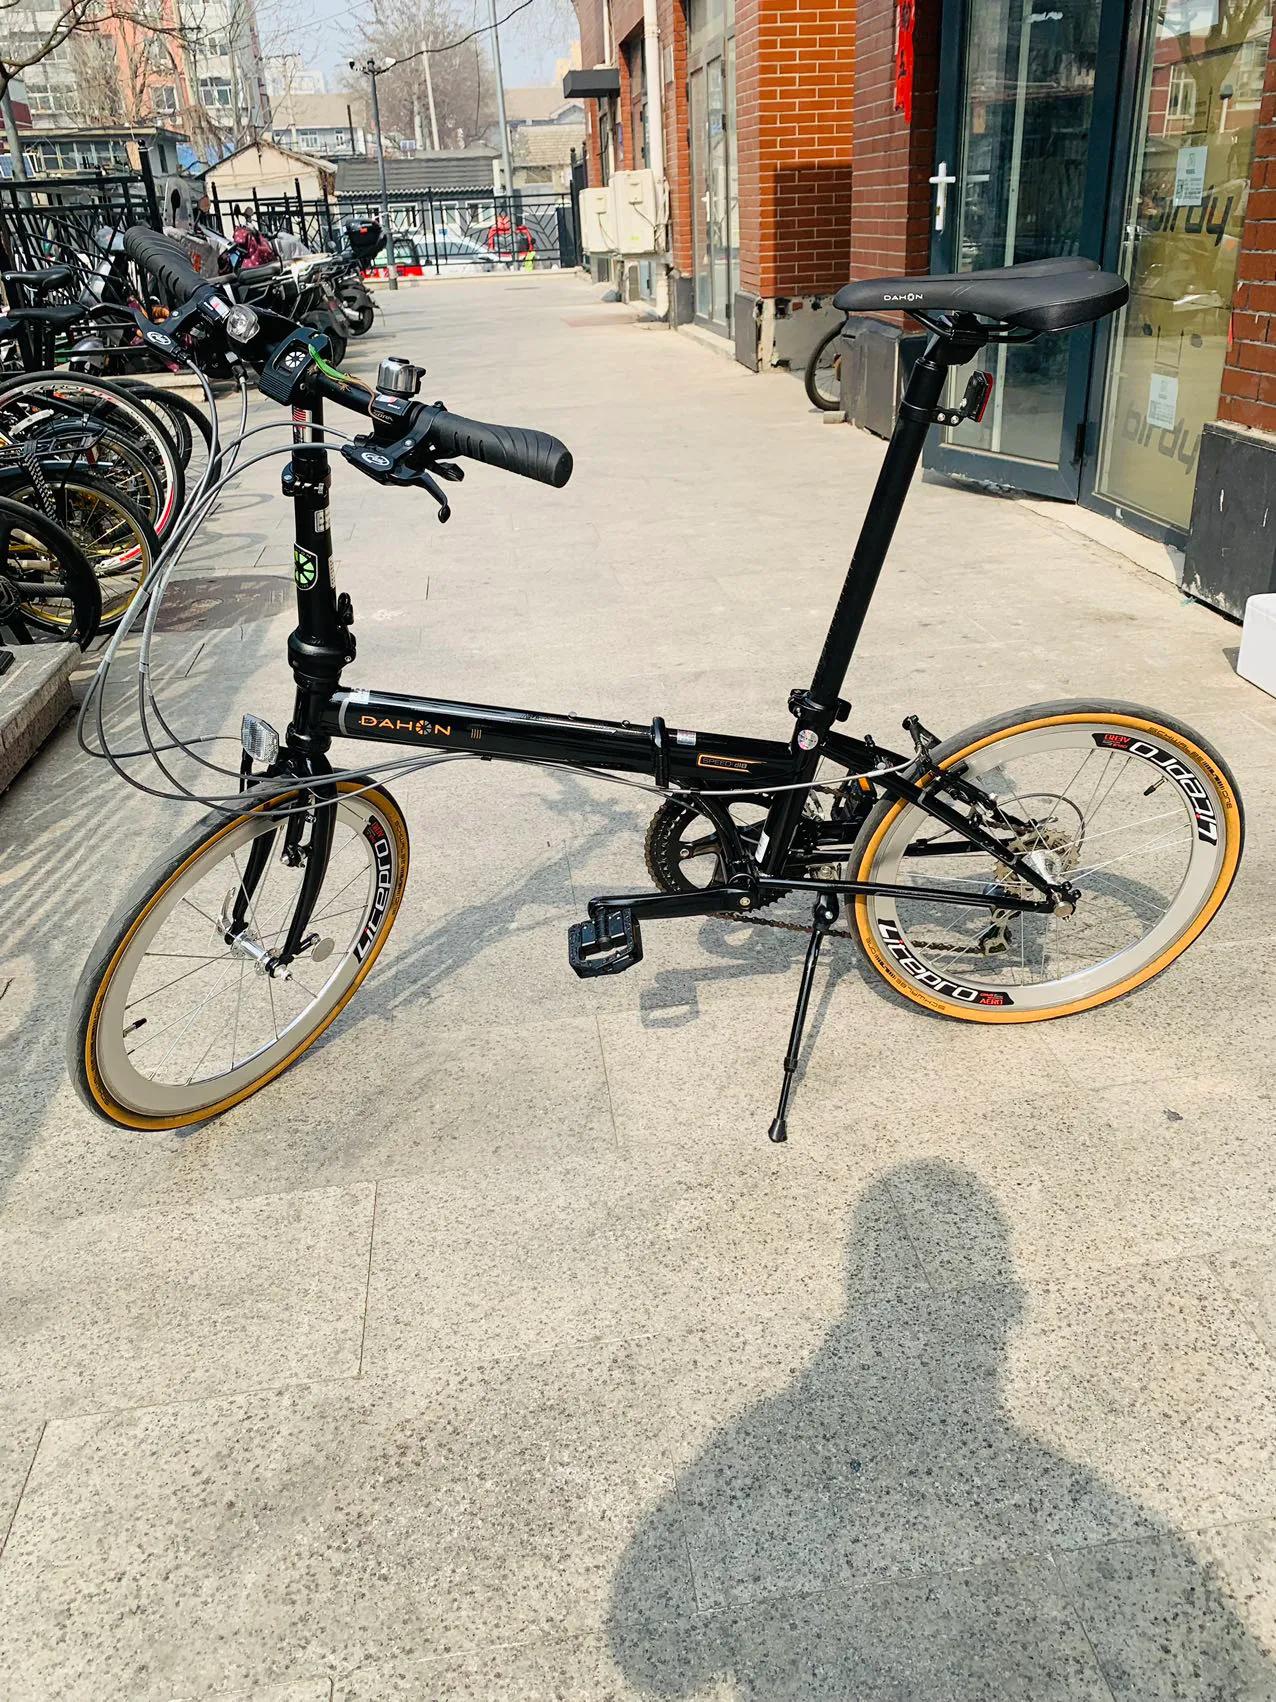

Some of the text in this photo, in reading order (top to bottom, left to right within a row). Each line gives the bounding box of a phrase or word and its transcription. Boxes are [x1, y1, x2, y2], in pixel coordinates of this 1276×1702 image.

[883, 293, 923, 302] DAHON
[359, 715, 451, 737] DAHON
[702, 757, 732, 767] SPEED
